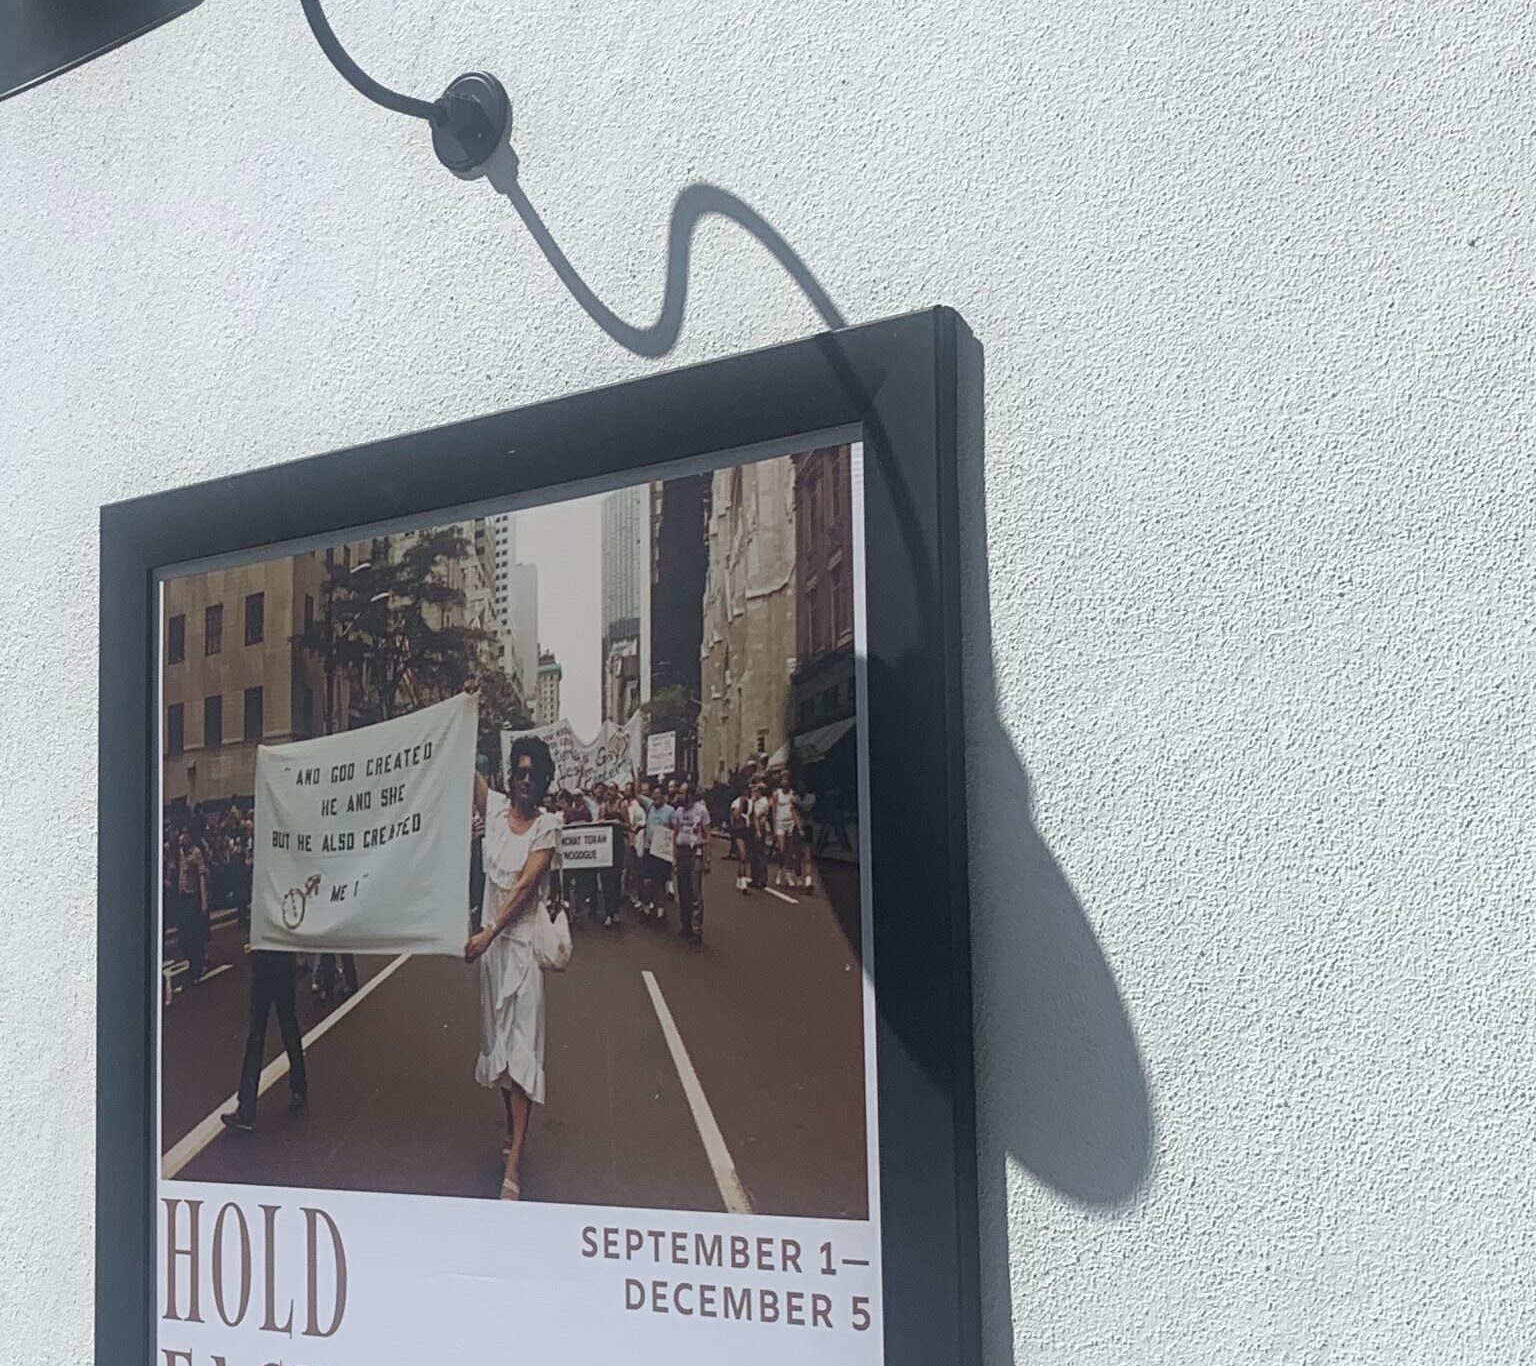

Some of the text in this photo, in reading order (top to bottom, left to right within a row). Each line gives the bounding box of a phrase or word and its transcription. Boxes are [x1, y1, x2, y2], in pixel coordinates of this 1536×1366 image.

[331, 763, 355, 783] GOD
[366, 742, 432, 777] CREATED
[321, 784, 406, 816] HE AND SHE
[272, 813, 421, 852] BUT HE ALSO CREATED
[563, 849, 597, 860] NOGOGUE
[161, 1198, 348, 1339] HOLD
[581, 1226, 803, 1273] SEPTEMBER
[625, 1278, 871, 1331] DECEMBER 5
